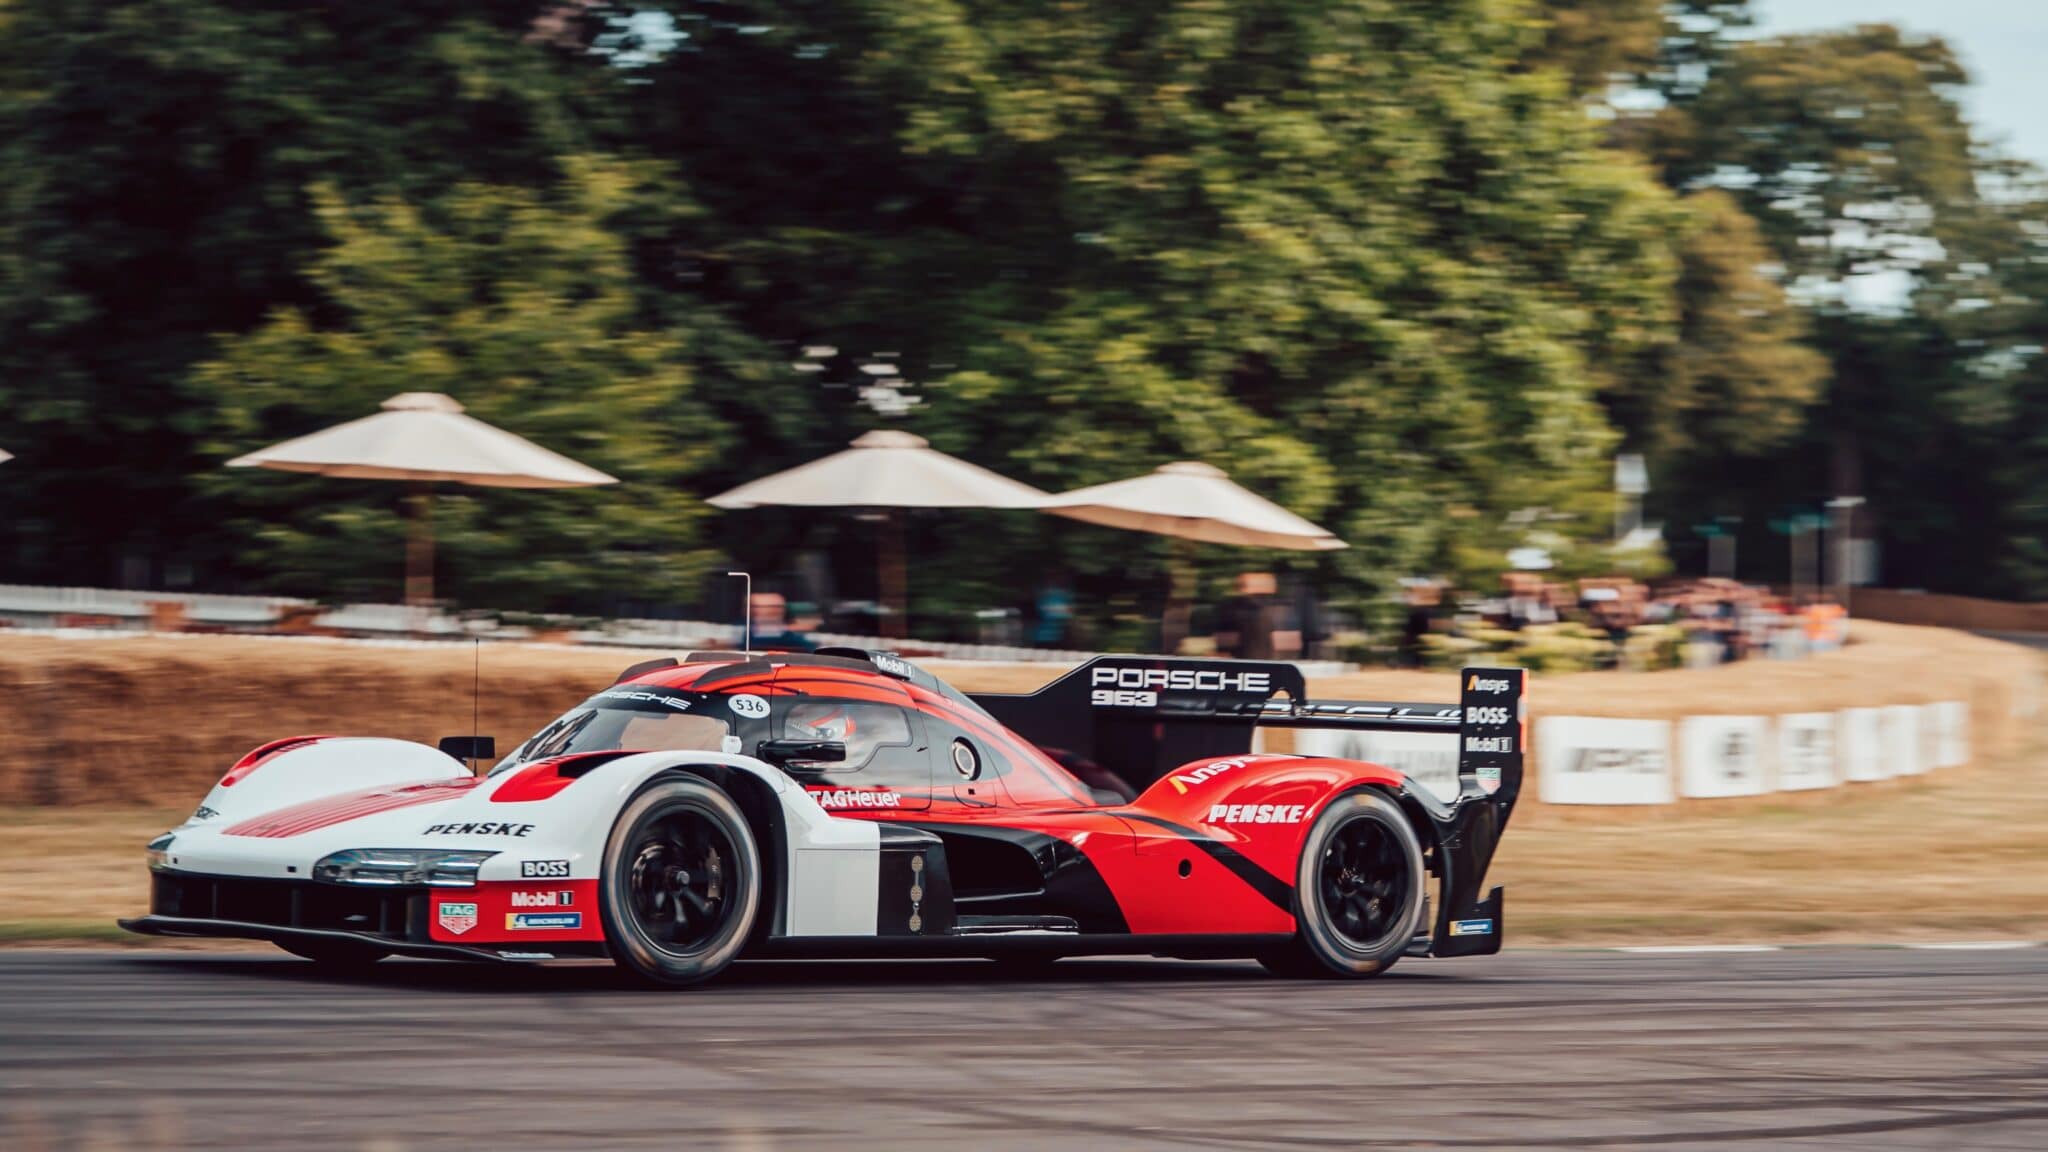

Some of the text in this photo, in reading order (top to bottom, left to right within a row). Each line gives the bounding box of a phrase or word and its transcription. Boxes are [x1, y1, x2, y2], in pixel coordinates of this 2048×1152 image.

[876, 655, 904, 674] Mobil
[1091, 667, 1271, 692] PORSCHE
[735, 699, 764, 713] 536
[1091, 689, 1158, 707] 963
[1466, 706, 1508, 725] BOSS
[1465, 737, 1500, 752] Mobil
[1207, 804, 1305, 824] PENSKE
[423, 822, 536, 838] PENSKE
[524, 861, 569, 877] BOSS
[511, 891, 557, 907] Mobil
[441, 905, 474, 915] TAG
